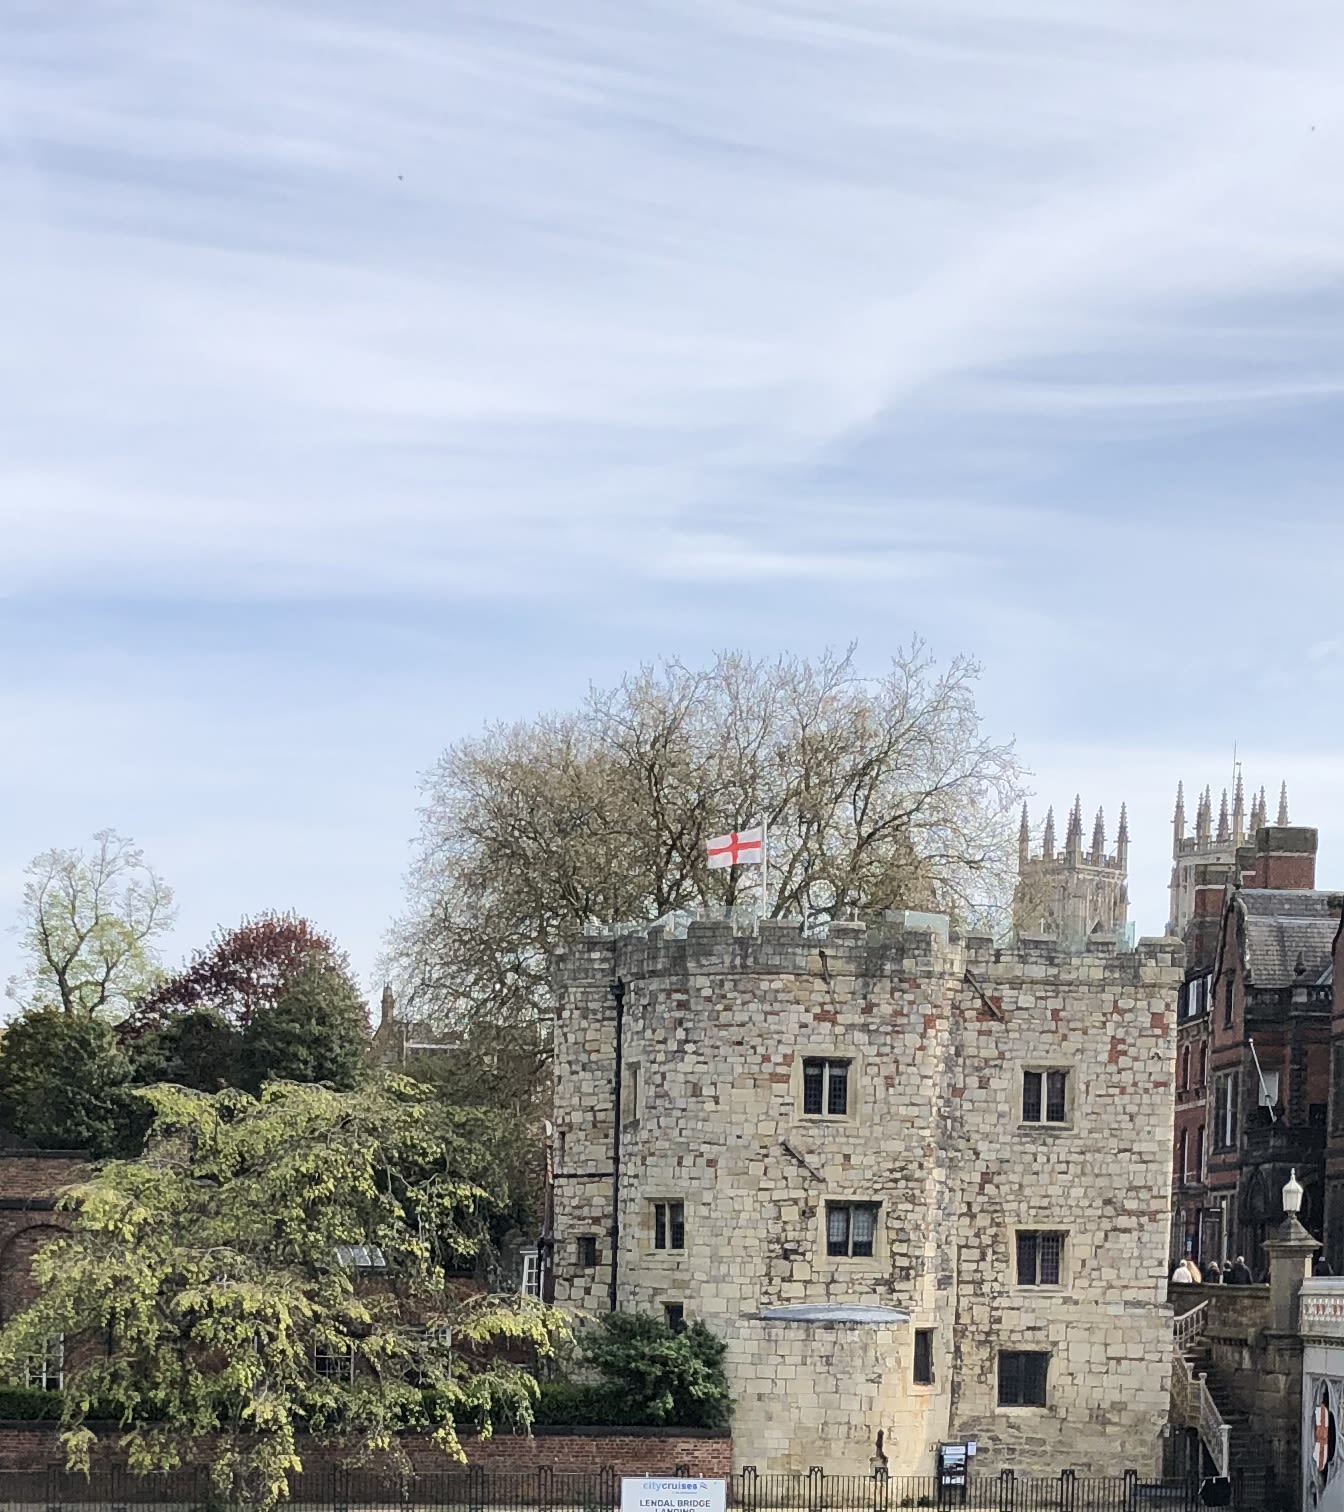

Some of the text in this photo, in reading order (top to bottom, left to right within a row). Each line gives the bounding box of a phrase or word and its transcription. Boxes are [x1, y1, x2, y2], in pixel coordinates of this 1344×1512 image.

[642, 1481, 698, 1491] citycruises
[639, 1499, 711, 1507] LENDAL BRIDGE
